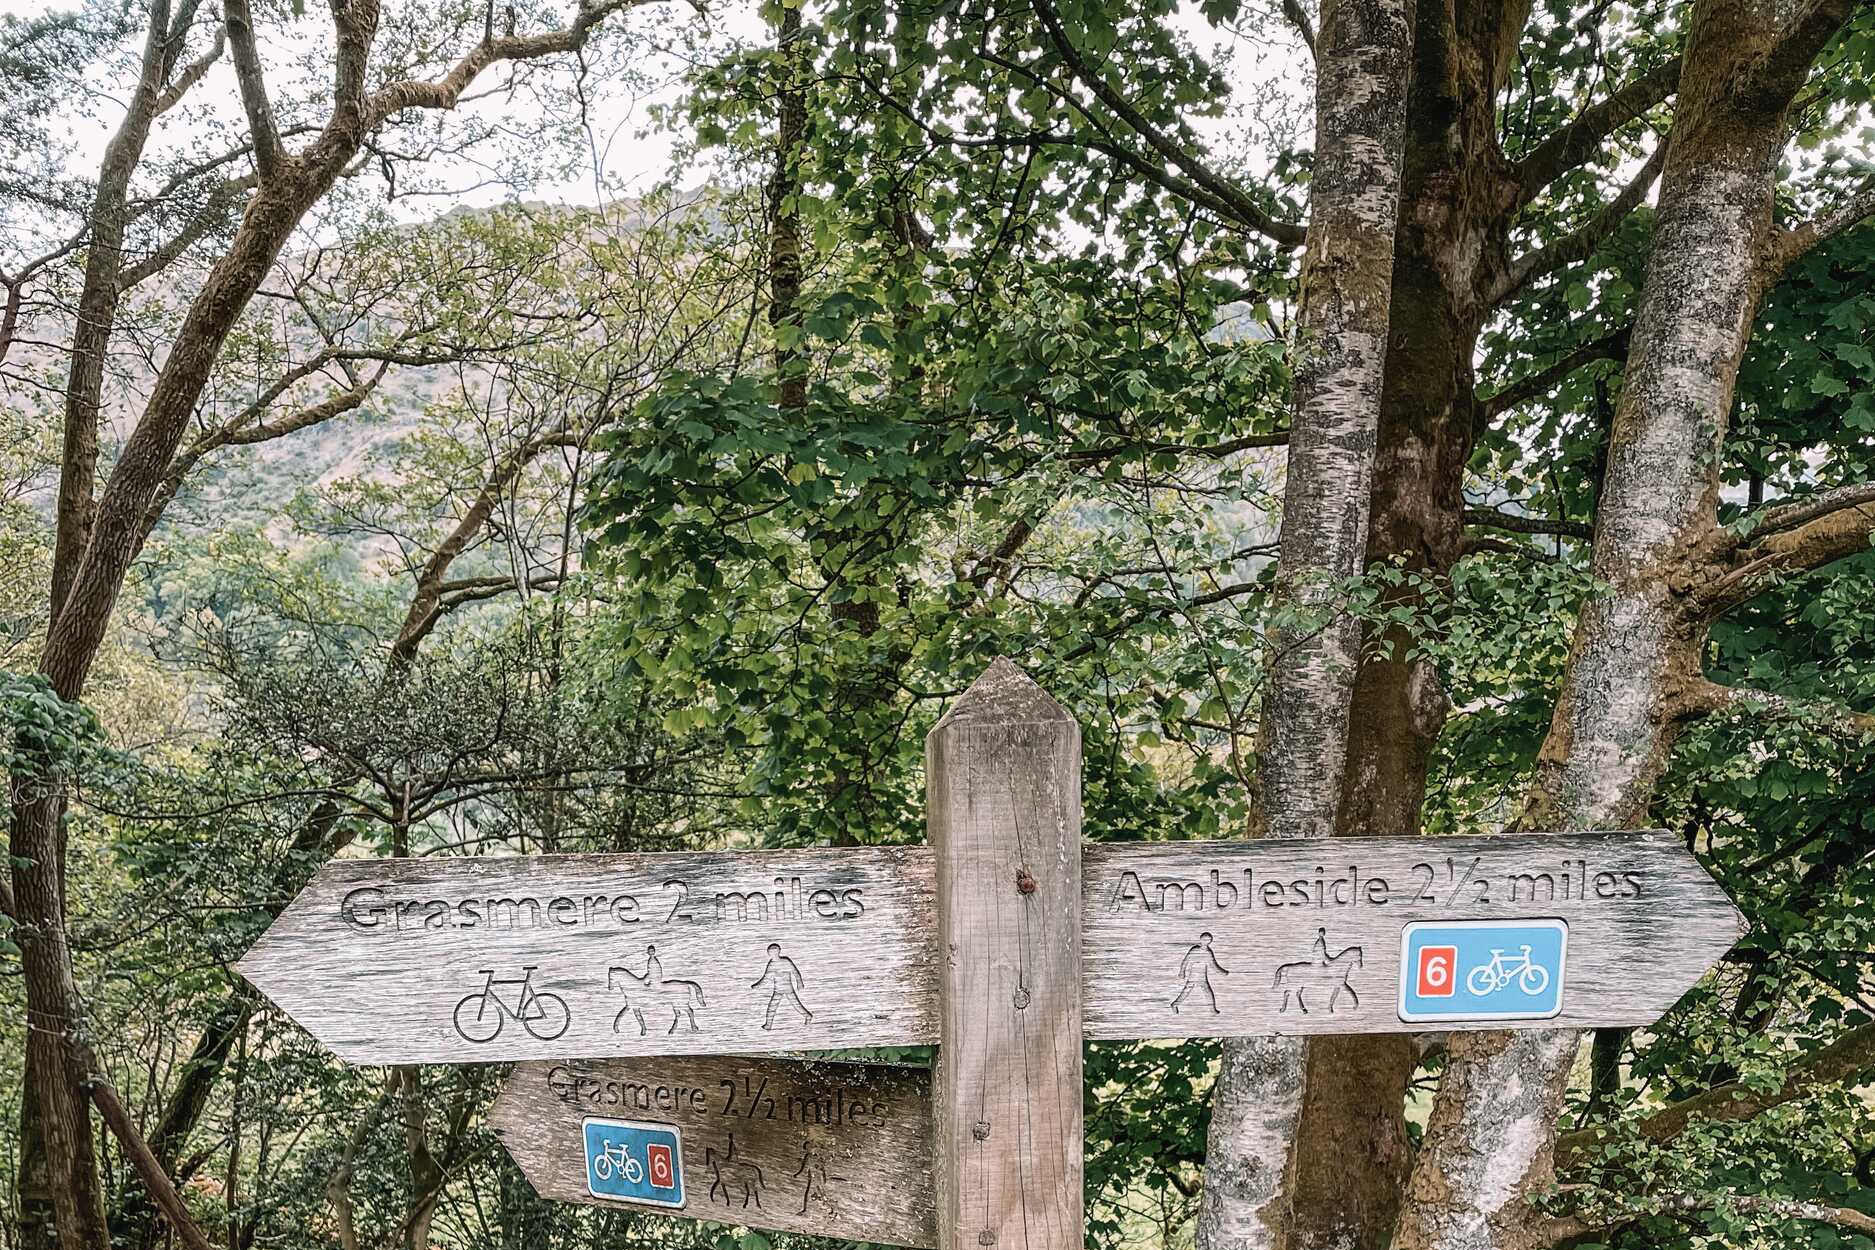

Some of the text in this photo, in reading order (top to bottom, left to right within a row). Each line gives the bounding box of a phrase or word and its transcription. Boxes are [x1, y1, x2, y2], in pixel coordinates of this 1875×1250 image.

[341, 877, 866, 936] Grasmere 2 miles
[1108, 865, 1390, 913] Ambleside
[1508, 859, 1643, 903] miles
[1425, 955, 1448, 988] 6
[547, 1066, 708, 1115] Grasmere
[787, 1086, 889, 1129] miles
[654, 1153, 669, 1181] 6
